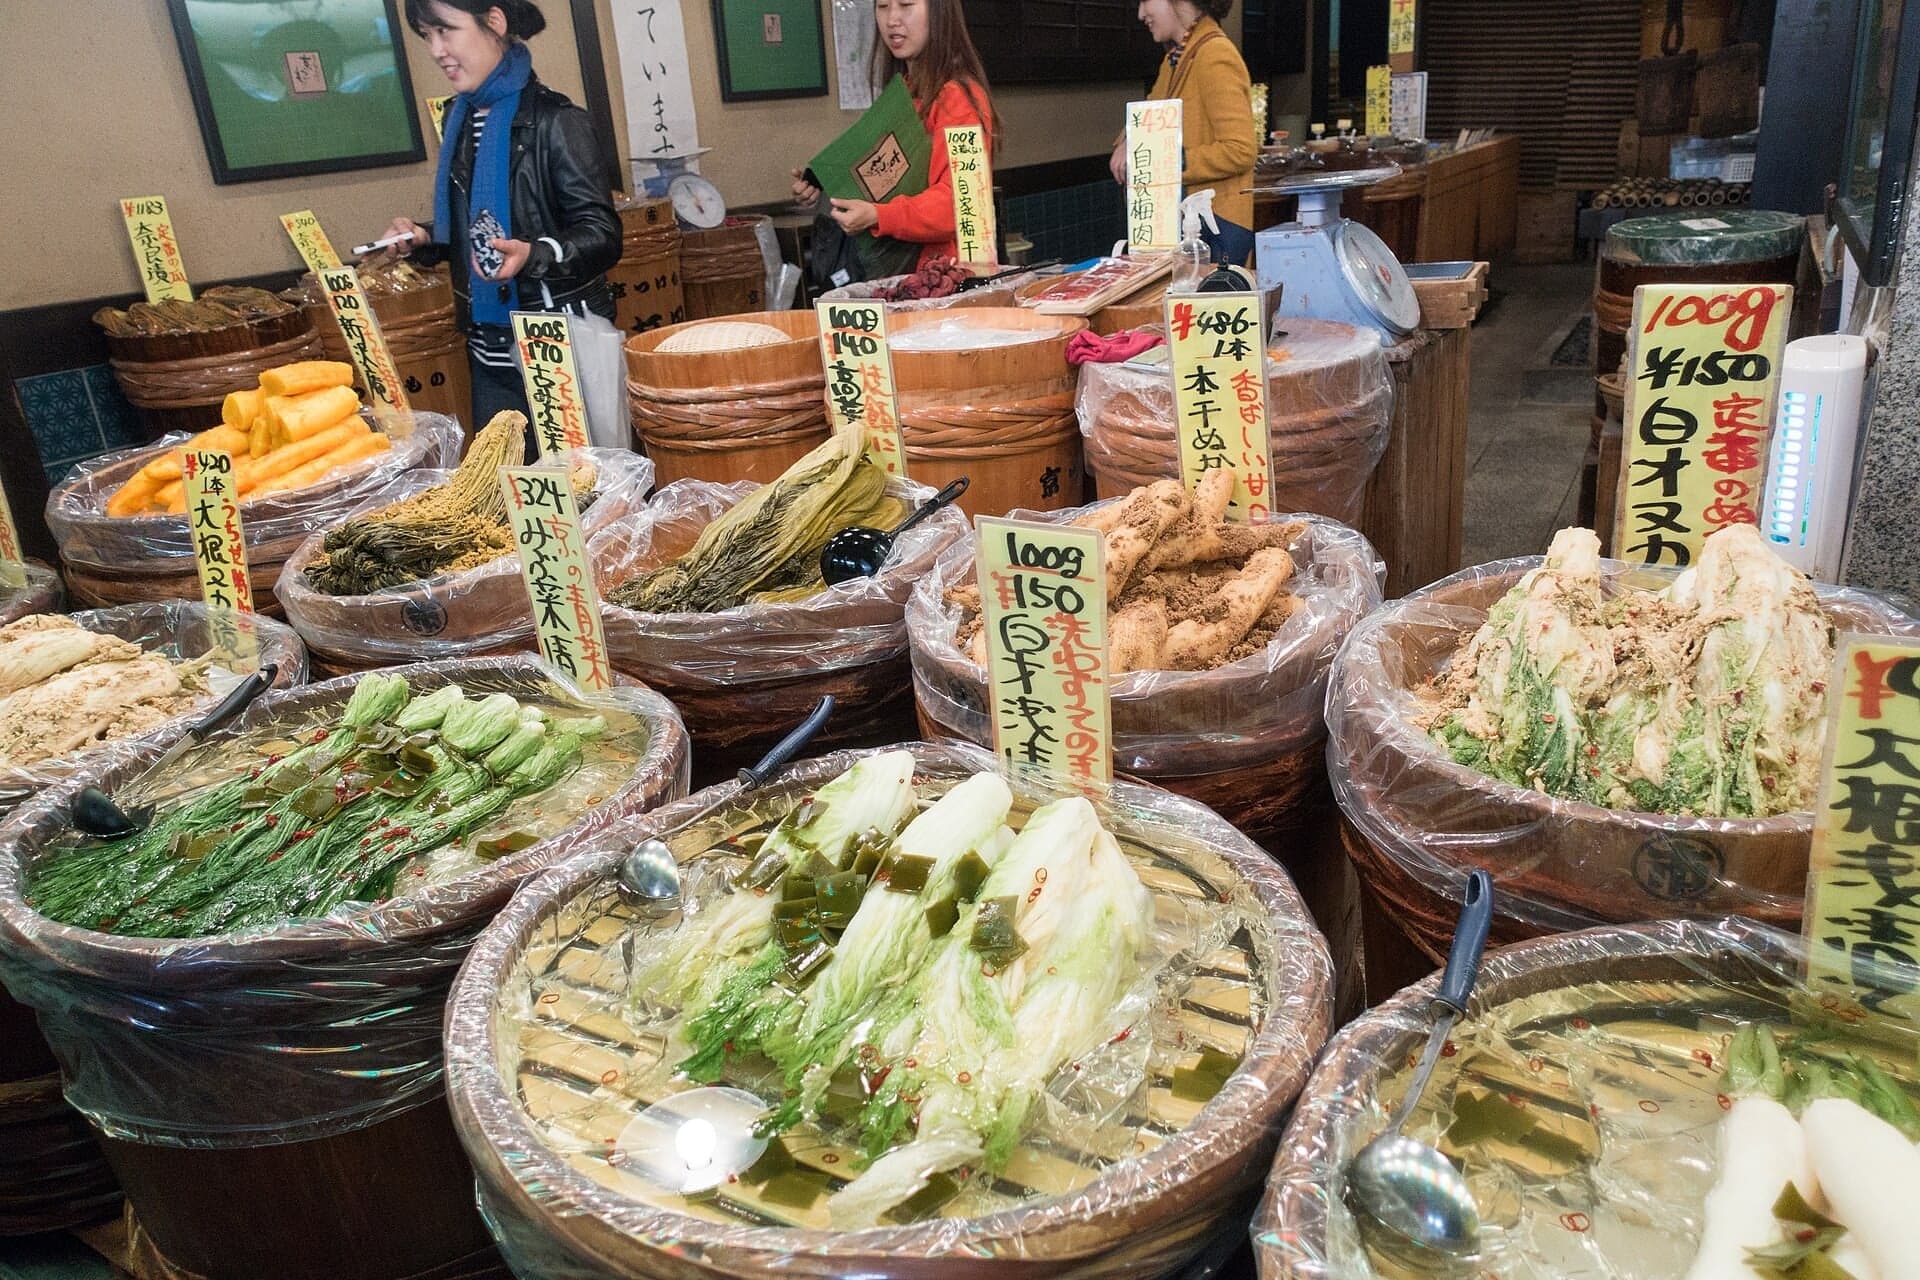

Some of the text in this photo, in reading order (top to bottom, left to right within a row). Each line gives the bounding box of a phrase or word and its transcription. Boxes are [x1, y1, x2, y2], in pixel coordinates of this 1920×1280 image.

[958, 176, 979, 262] 自家梅干
[1130, 142, 1154, 246] 自家梅肉
[1638, 346, 1771, 390] ¥150
[1183, 365, 1236, 488] 本干ぬか
[507, 473, 566, 514] ¥324
[1701, 392, 1768, 538] 定番のぬ
[1006, 532, 1085, 578] 100g
[990, 571, 1085, 614] ¥150
